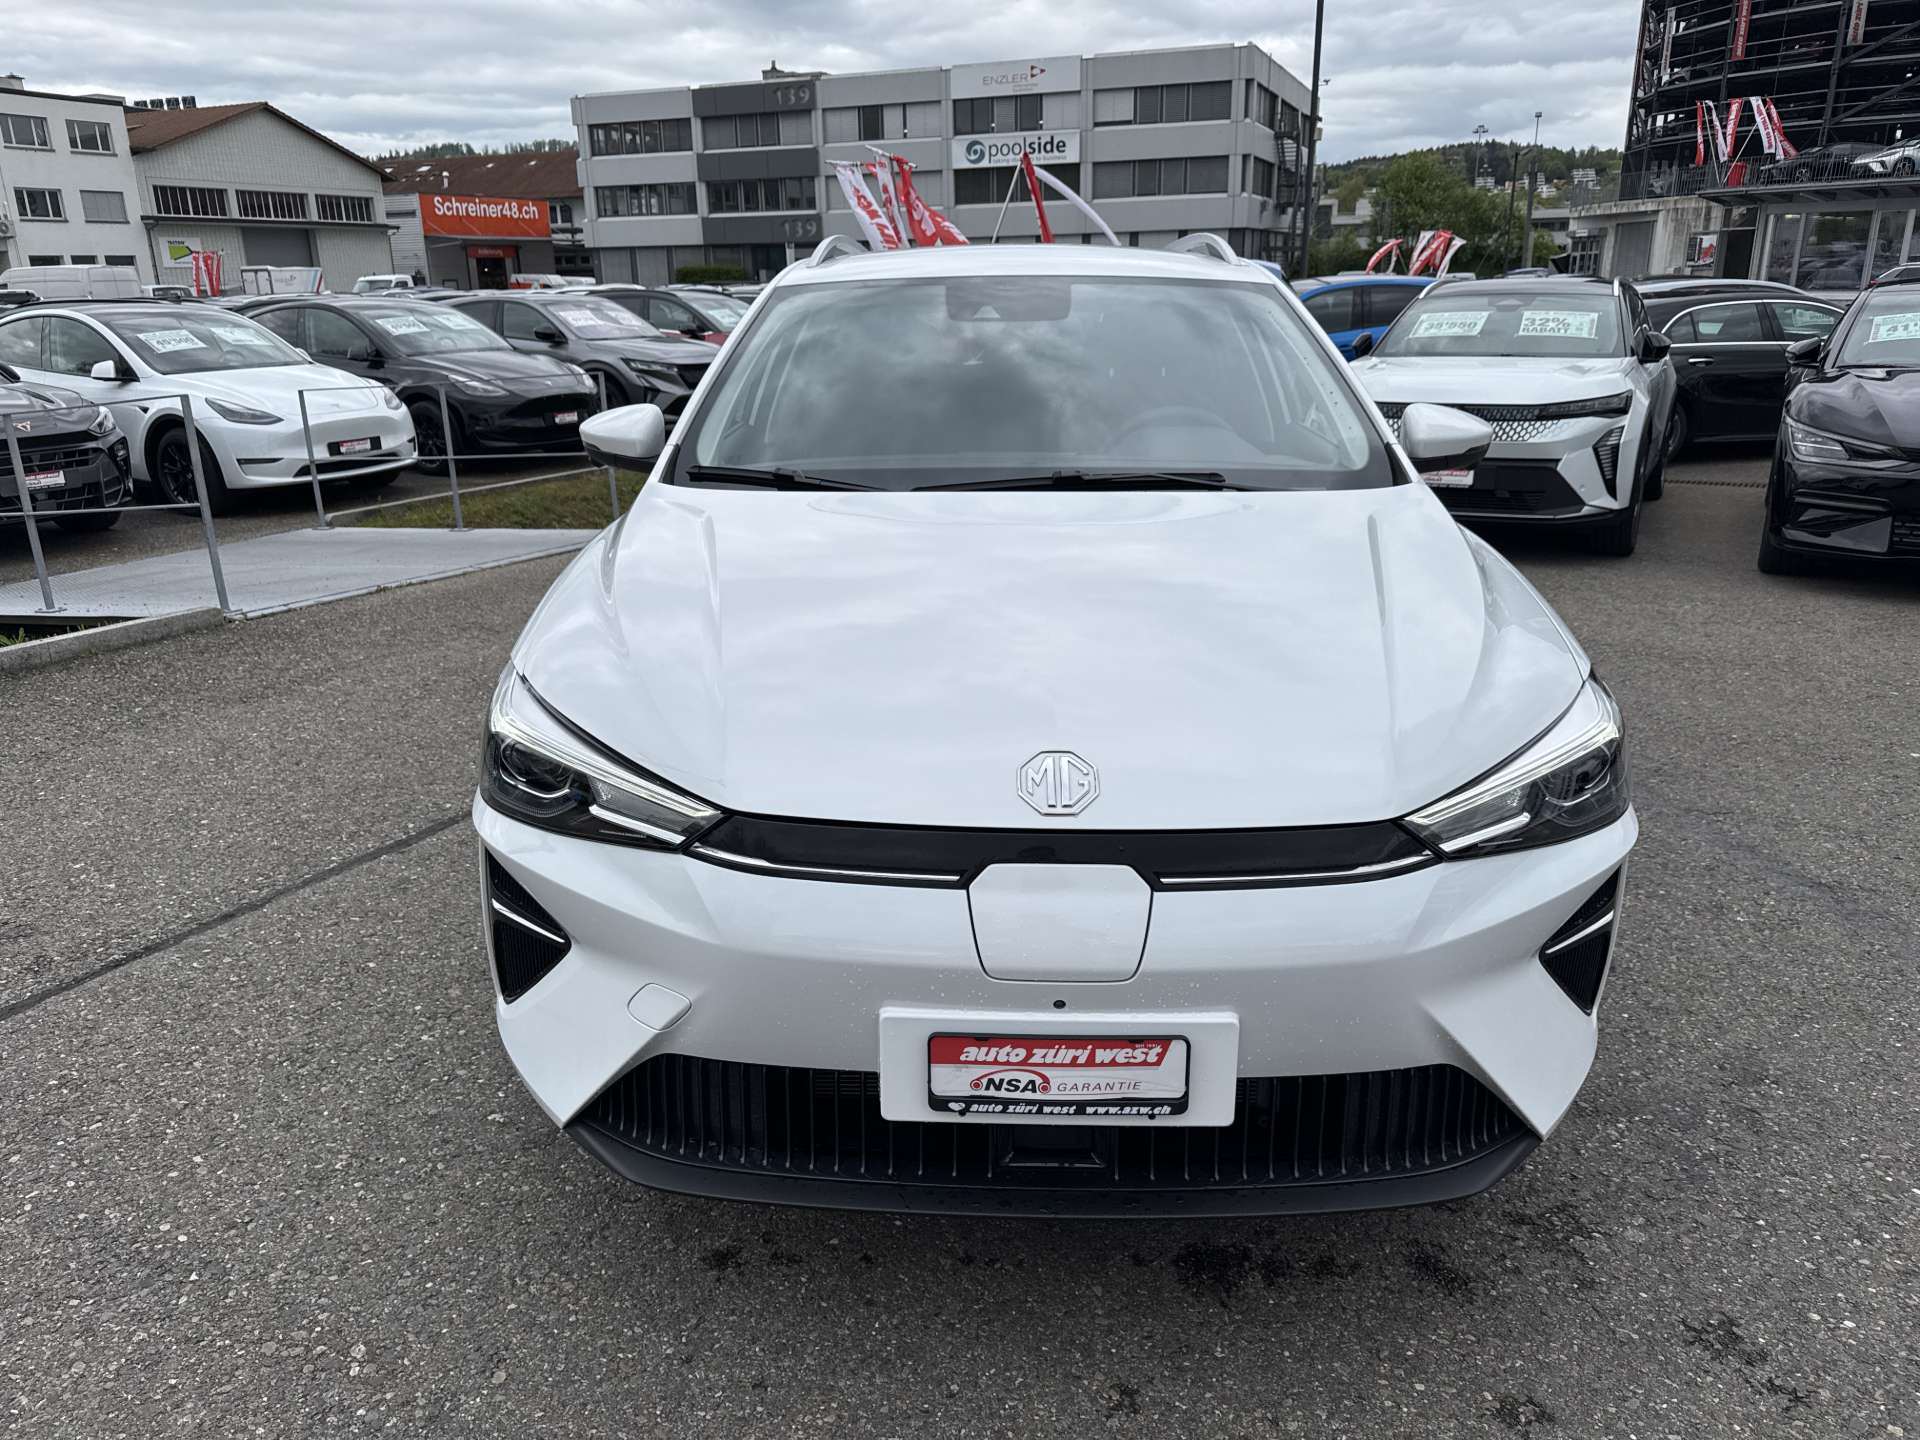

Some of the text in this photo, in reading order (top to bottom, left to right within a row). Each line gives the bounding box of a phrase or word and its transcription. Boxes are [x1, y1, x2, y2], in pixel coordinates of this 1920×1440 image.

[983, 73, 1028, 85] ENZLER
[776, 87, 810, 105] 139
[988, 136, 1069, 163] poolside
[434, 196, 539, 219] Schreiner48.ch
[784, 219, 817, 238] 139
[1523, 317, 1570, 328] 32%
[1025, 755, 1090, 808] MG
[960, 1044, 1162, 1064] auto züri west
[985, 1078, 1037, 1093] NSA
[1057, 1081, 1142, 1093] GARANTIE
[970, 1102, 1172, 1115] auto züri west www.azw.ch
